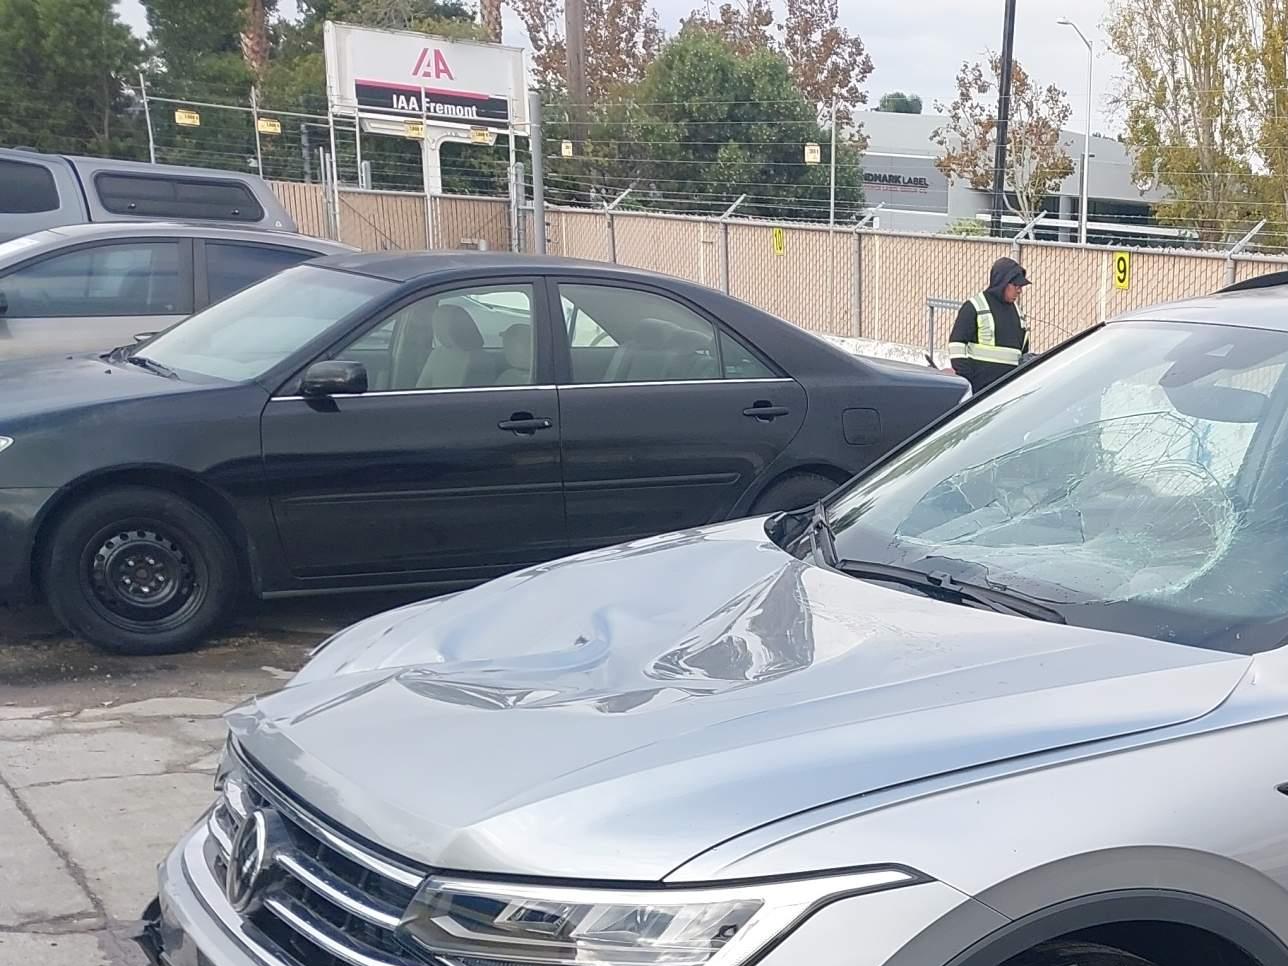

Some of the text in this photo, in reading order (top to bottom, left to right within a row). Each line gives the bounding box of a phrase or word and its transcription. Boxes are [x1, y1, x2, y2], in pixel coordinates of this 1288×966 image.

[393, 94, 478, 117] IAA Fremont
[902, 176, 928, 186] LABEL
[1117, 256, 1126, 283] 9
